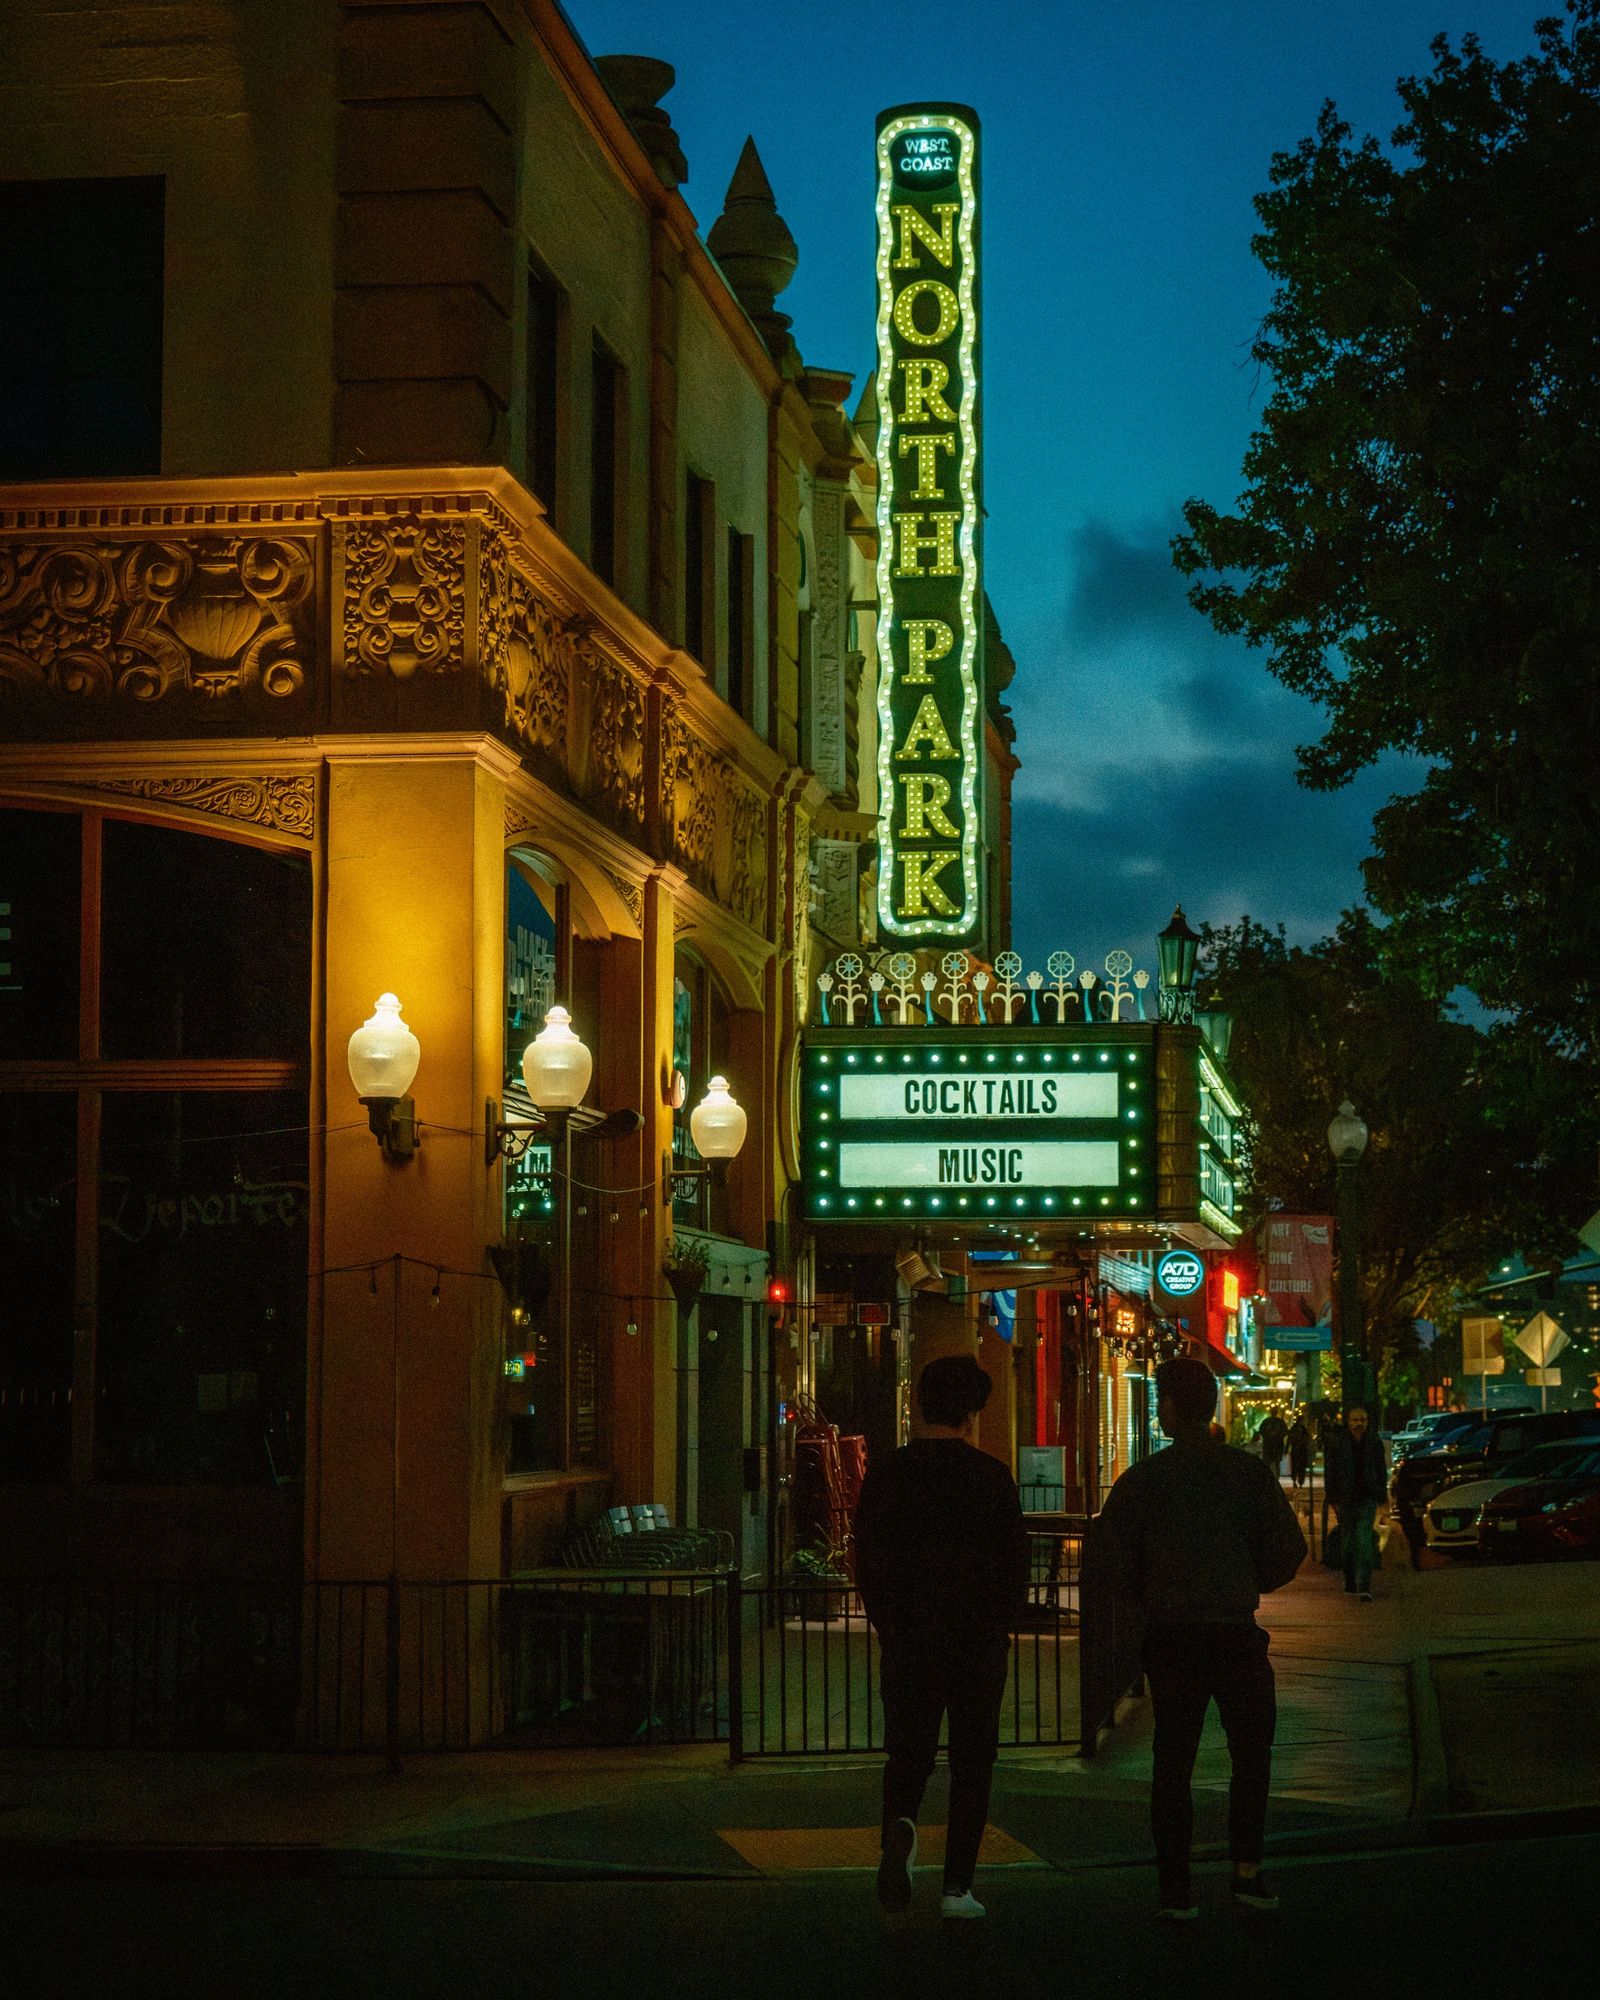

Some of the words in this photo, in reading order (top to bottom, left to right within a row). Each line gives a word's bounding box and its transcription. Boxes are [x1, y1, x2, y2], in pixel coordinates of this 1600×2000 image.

[904, 138, 951, 154] WEST
[900, 156, 954, 173] COAST
[891, 203, 962, 579] NORTH
[895, 618, 962, 917] PARK
[904, 1079, 1058, 1115] COCKTAILS
[938, 1148, 1023, 1184] MUSIC
